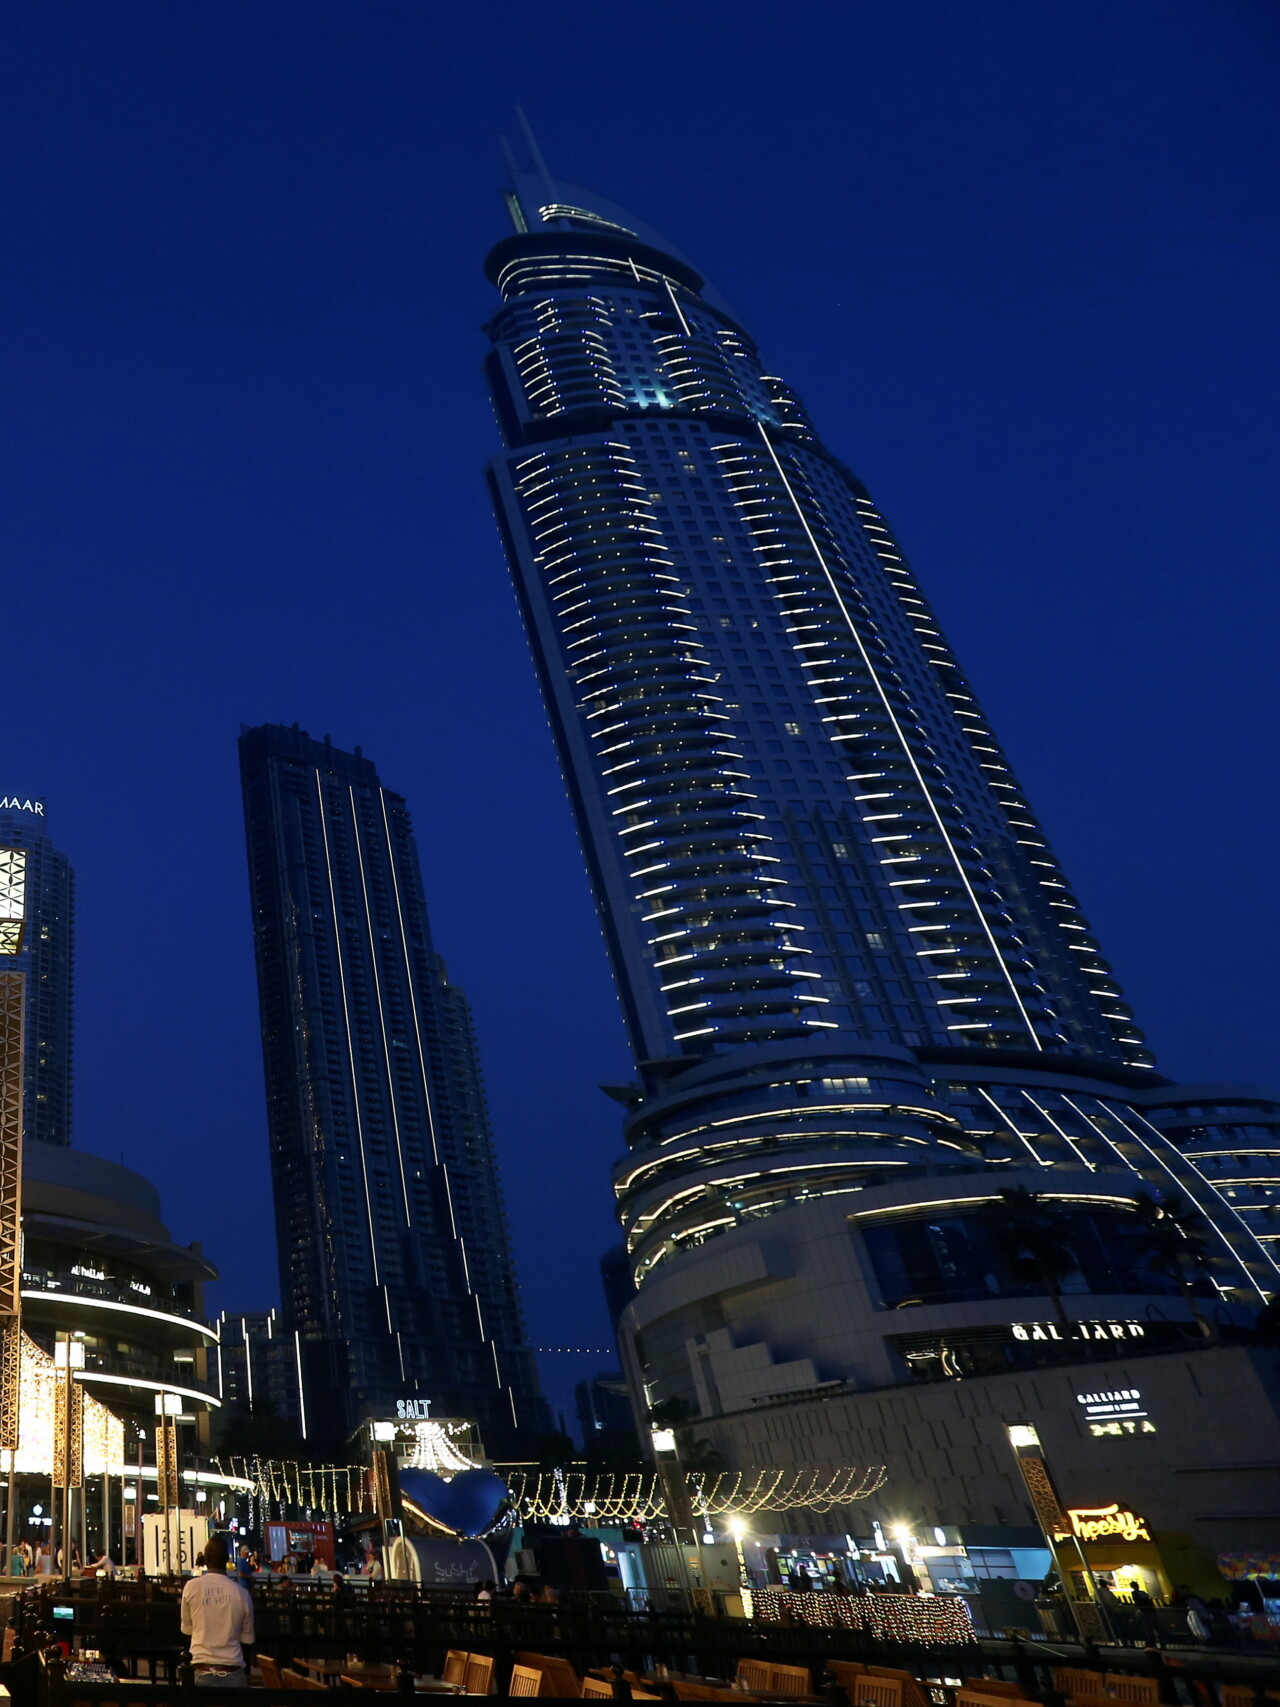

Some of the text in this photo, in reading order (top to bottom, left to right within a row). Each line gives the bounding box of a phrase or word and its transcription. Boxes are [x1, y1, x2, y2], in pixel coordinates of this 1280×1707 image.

[1010, 1319, 1145, 1341] GALIARD
[1077, 1389, 1141, 1404] GALLIARD
[396, 1399, 432, 1419] SALT
